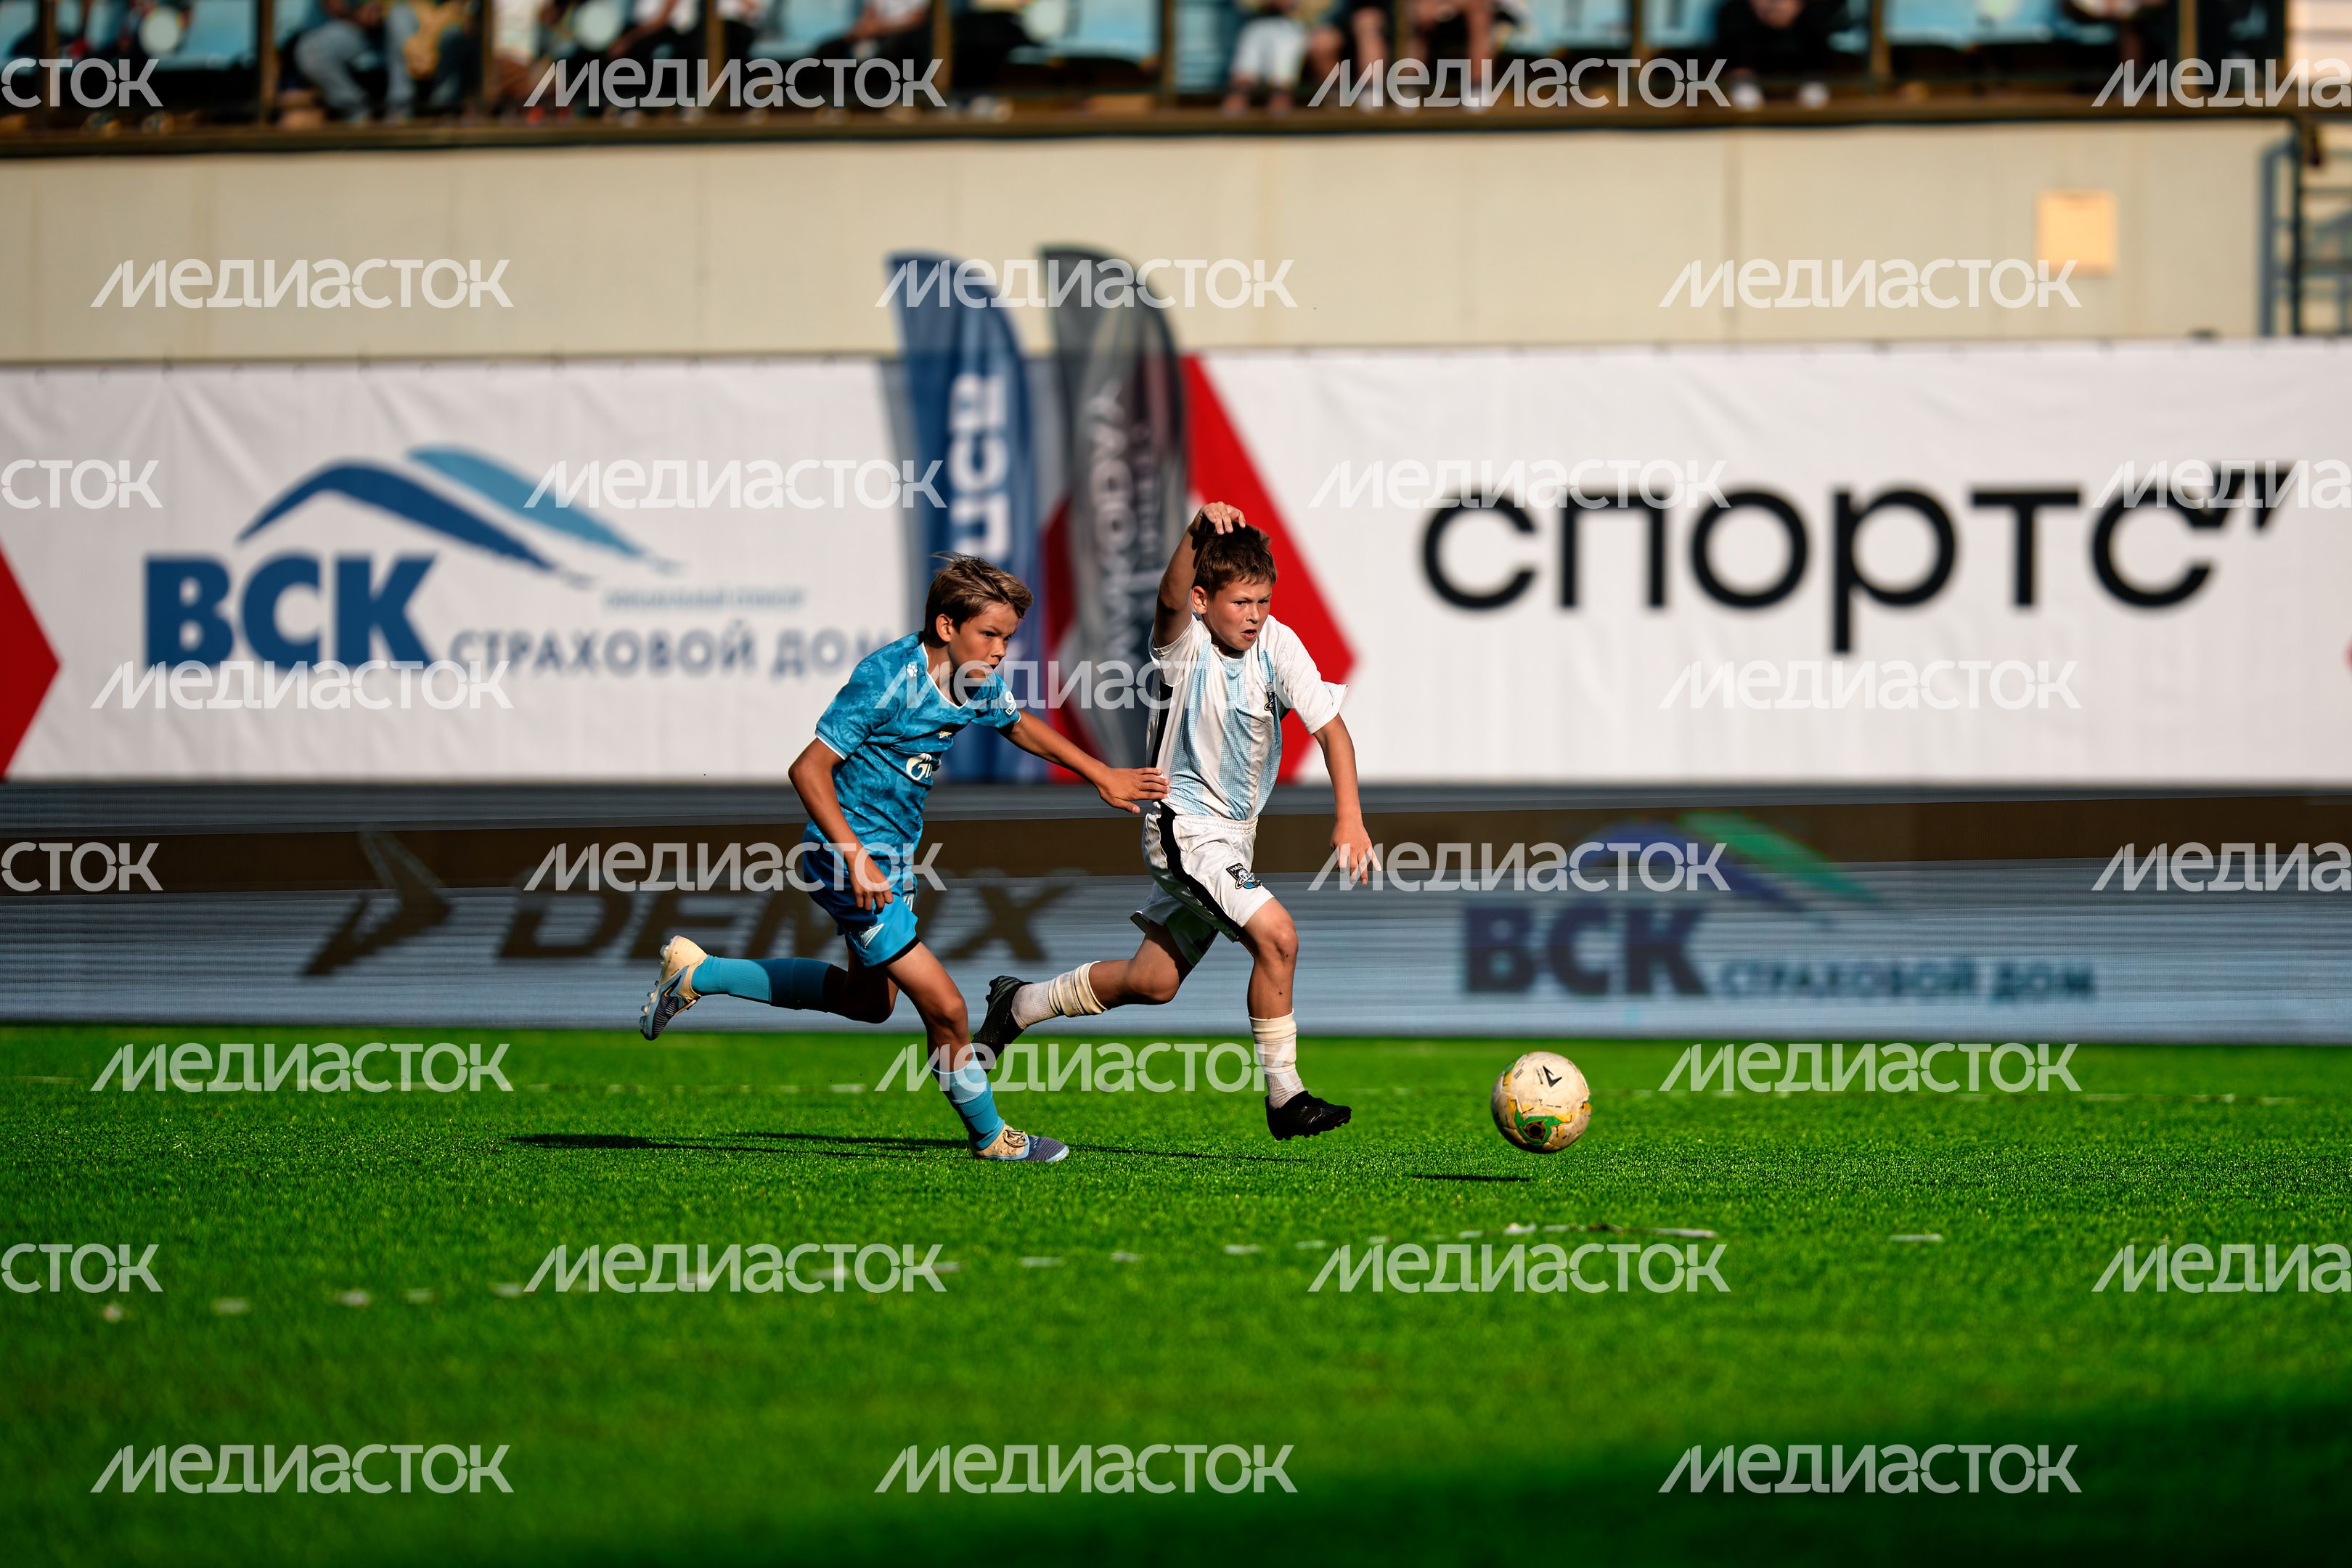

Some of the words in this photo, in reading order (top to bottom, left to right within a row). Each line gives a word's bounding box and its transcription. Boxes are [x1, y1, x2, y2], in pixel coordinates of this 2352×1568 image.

[144, 552, 440, 671] ВСК
[450, 618, 756, 678] СТРАХОВОЙ
[1463, 902, 1709, 996] ВСК
